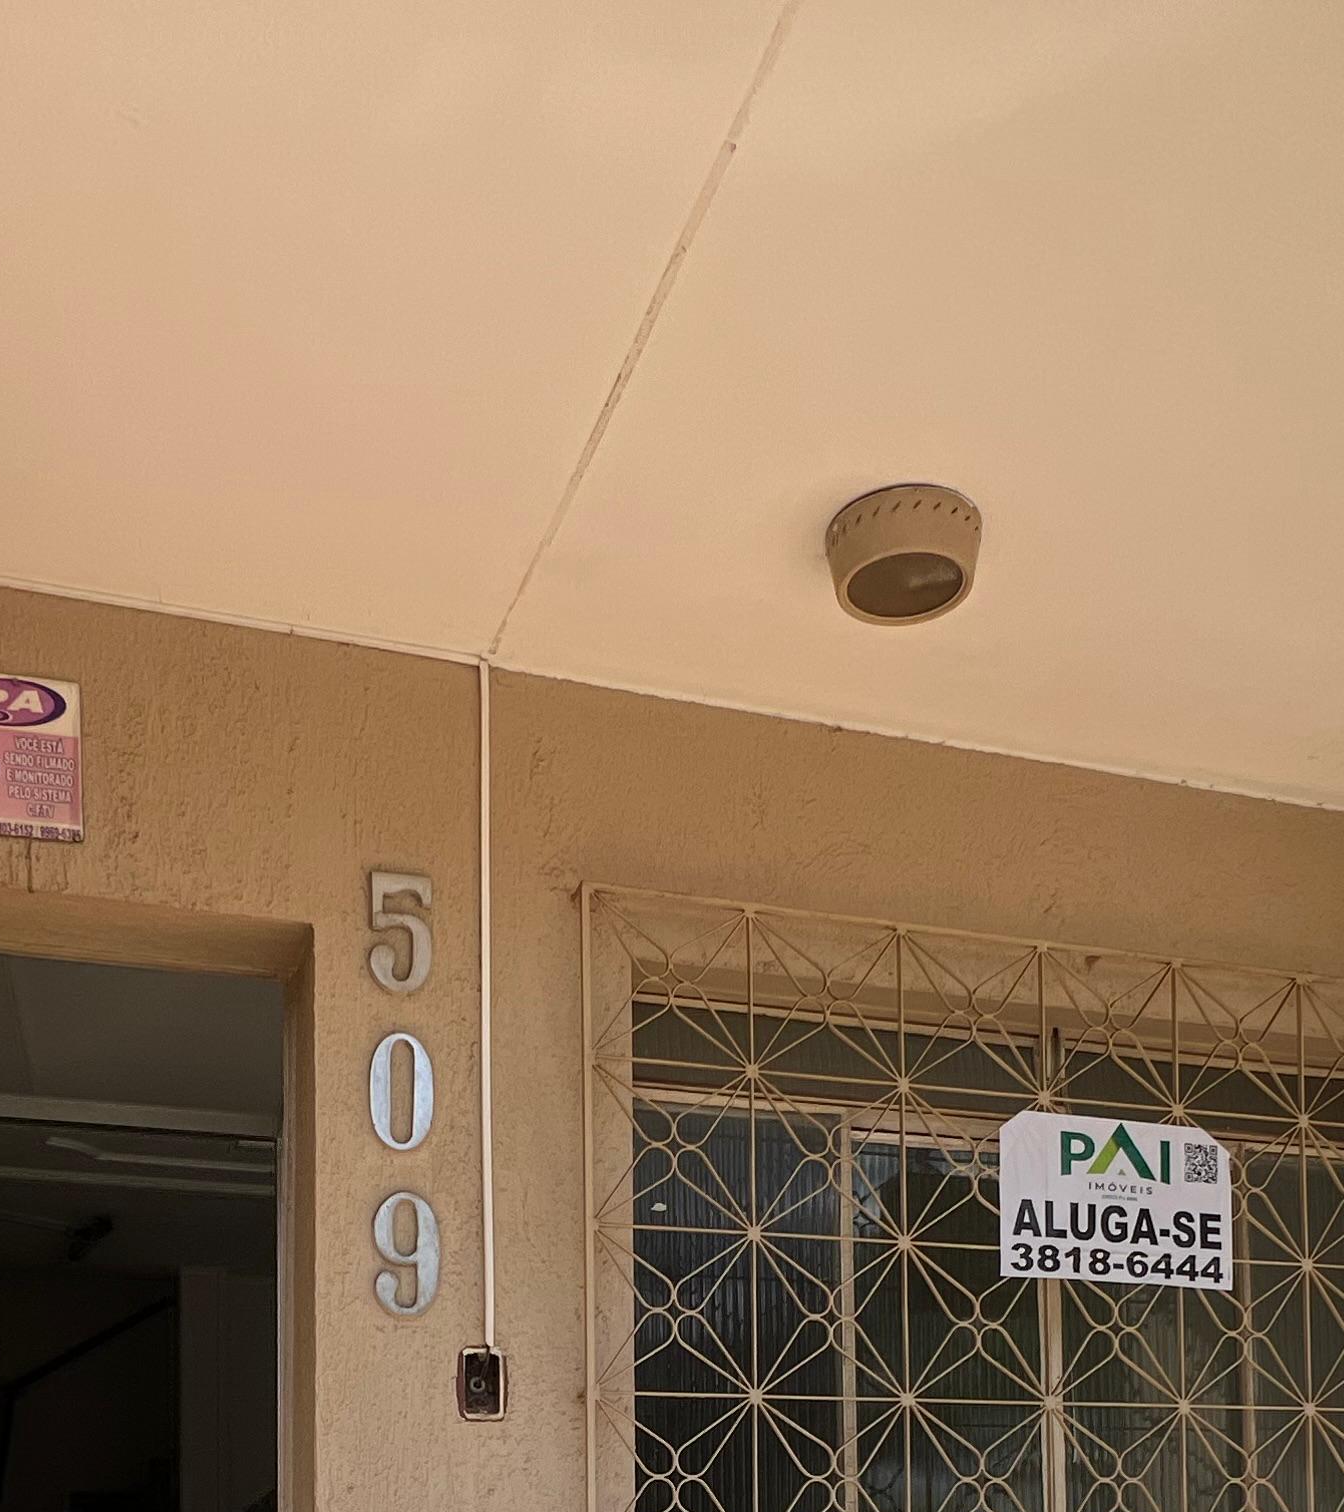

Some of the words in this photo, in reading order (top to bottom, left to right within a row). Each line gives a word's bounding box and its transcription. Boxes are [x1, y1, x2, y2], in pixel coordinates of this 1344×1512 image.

[39, 737, 64, 754] ESTÁ
[4, 751, 34, 767] SENDO
[36, 755, 75, 771] FILMADO
[6, 768, 13, 781] E
[14, 769, 73, 787] MONITORADO
[8, 785, 31, 799] PELO
[33, 787, 72, 803] SISTEMA
[369, 871, 441, 1318] 509
[1060, 1122, 1171, 1185] PAI
[1088, 1181, 1153, 1196] IMÓVEIS
[1013, 1199, 1222, 1250] ALUGA-SE
[1010, 1243, 1223, 1283] 3818-6444
